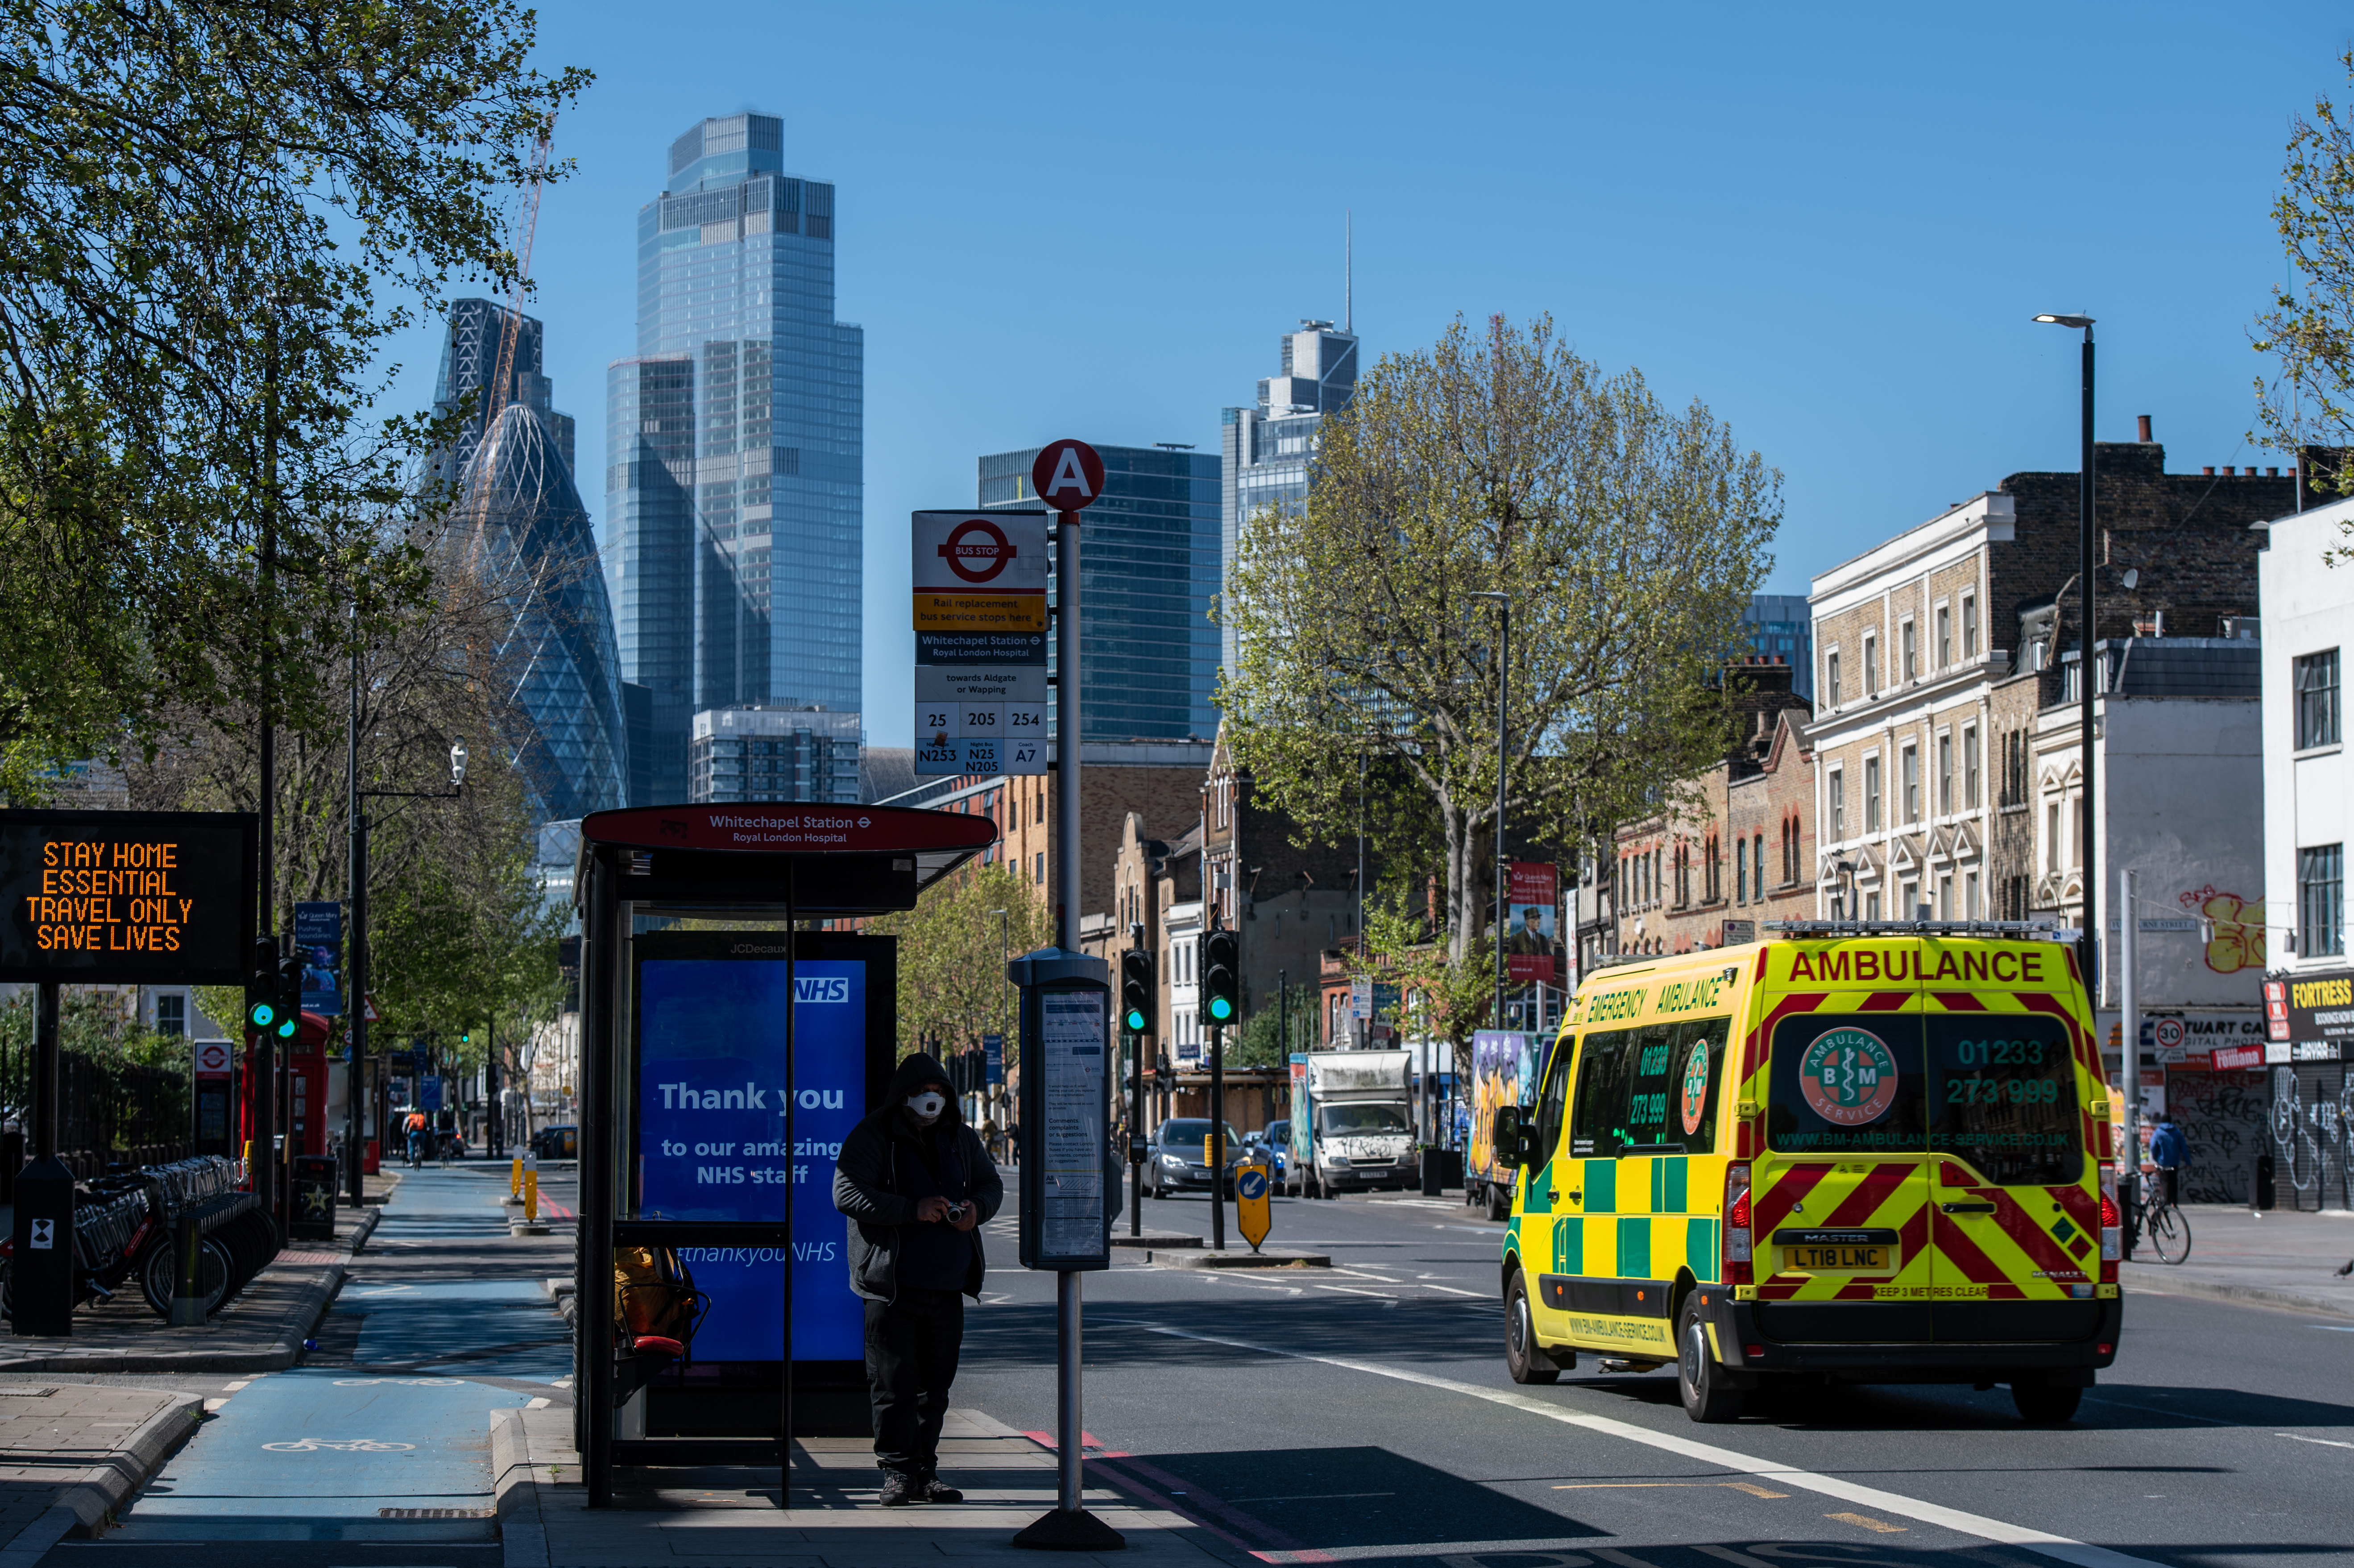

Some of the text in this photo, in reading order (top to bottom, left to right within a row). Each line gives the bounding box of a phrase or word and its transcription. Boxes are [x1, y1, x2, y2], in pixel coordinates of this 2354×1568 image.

[1045, 448, 1092, 496] A
[976, 547, 999, 555] STOP
[934, 599, 1018, 609] Rail replacement
[920, 612, 938, 621] bus
[941, 613, 976, 621] service
[979, 613, 1006, 623] stops
[922, 636, 1027, 646] Whitechapel Station
[933, 649, 956, 657] Royal
[994, 649, 1029, 658] Hospital
[983, 674, 1016, 683] Aldgate
[968, 686, 1006, 695] Wapping
[928, 714, 946, 727] 25
[968, 712, 995, 725] 205
[1012, 713, 1040, 726] 254
[919, 750, 956, 761] N253
[970, 749, 994, 759] N25
[1015, 749, 1036, 762] A7
[966, 761, 998, 772] N205
[709, 816, 853, 830] Whitechapel Station
[734, 833, 847, 844] Royal London Hospital
[44, 842, 177, 868] STAY HOME
[43, 869, 176, 896] ESSENTIAL
[26, 897, 192, 923] TRAVEL ONLY
[37, 925, 180, 951] SAVE LIVES
[730, 944, 786, 953] JCDecaux
[1789, 950, 2043, 982] AMBULANCE
[794, 979, 846, 1001] NHS
[2292, 979, 2352, 1009] FORTRESS
[1587, 976, 1723, 1023] EMERGENCY AMBULANCE
[2160, 1028, 2180, 1039] 30
[1810, 1034, 1889, 1068] AMBULANCE
[1957, 1039, 2043, 1065] 01233
[1640, 1045, 1669, 1076] 01233
[2217, 1051, 2259, 1069] romana
[1824, 1068, 1877, 1084] B M
[1946, 1079, 2058, 1103] 273 999
[659, 1082, 843, 1117] Thank you
[1630, 1092, 1666, 1124] 273 999
[1815, 1098, 1883, 1120] SERVICE
[661, 1139, 687, 1156] to
[695, 1142, 735, 1156] our
[1776, 1133, 2068, 1146] WWW.BM-AMBULANCE-SERVICE.CO.UK
[697, 1165, 808, 1184] NHS staff
[1795, 1249, 1878, 1266] LT18 LNC
[1874, 1287, 1989, 1297] KEEP 3 METRES CLEAR
